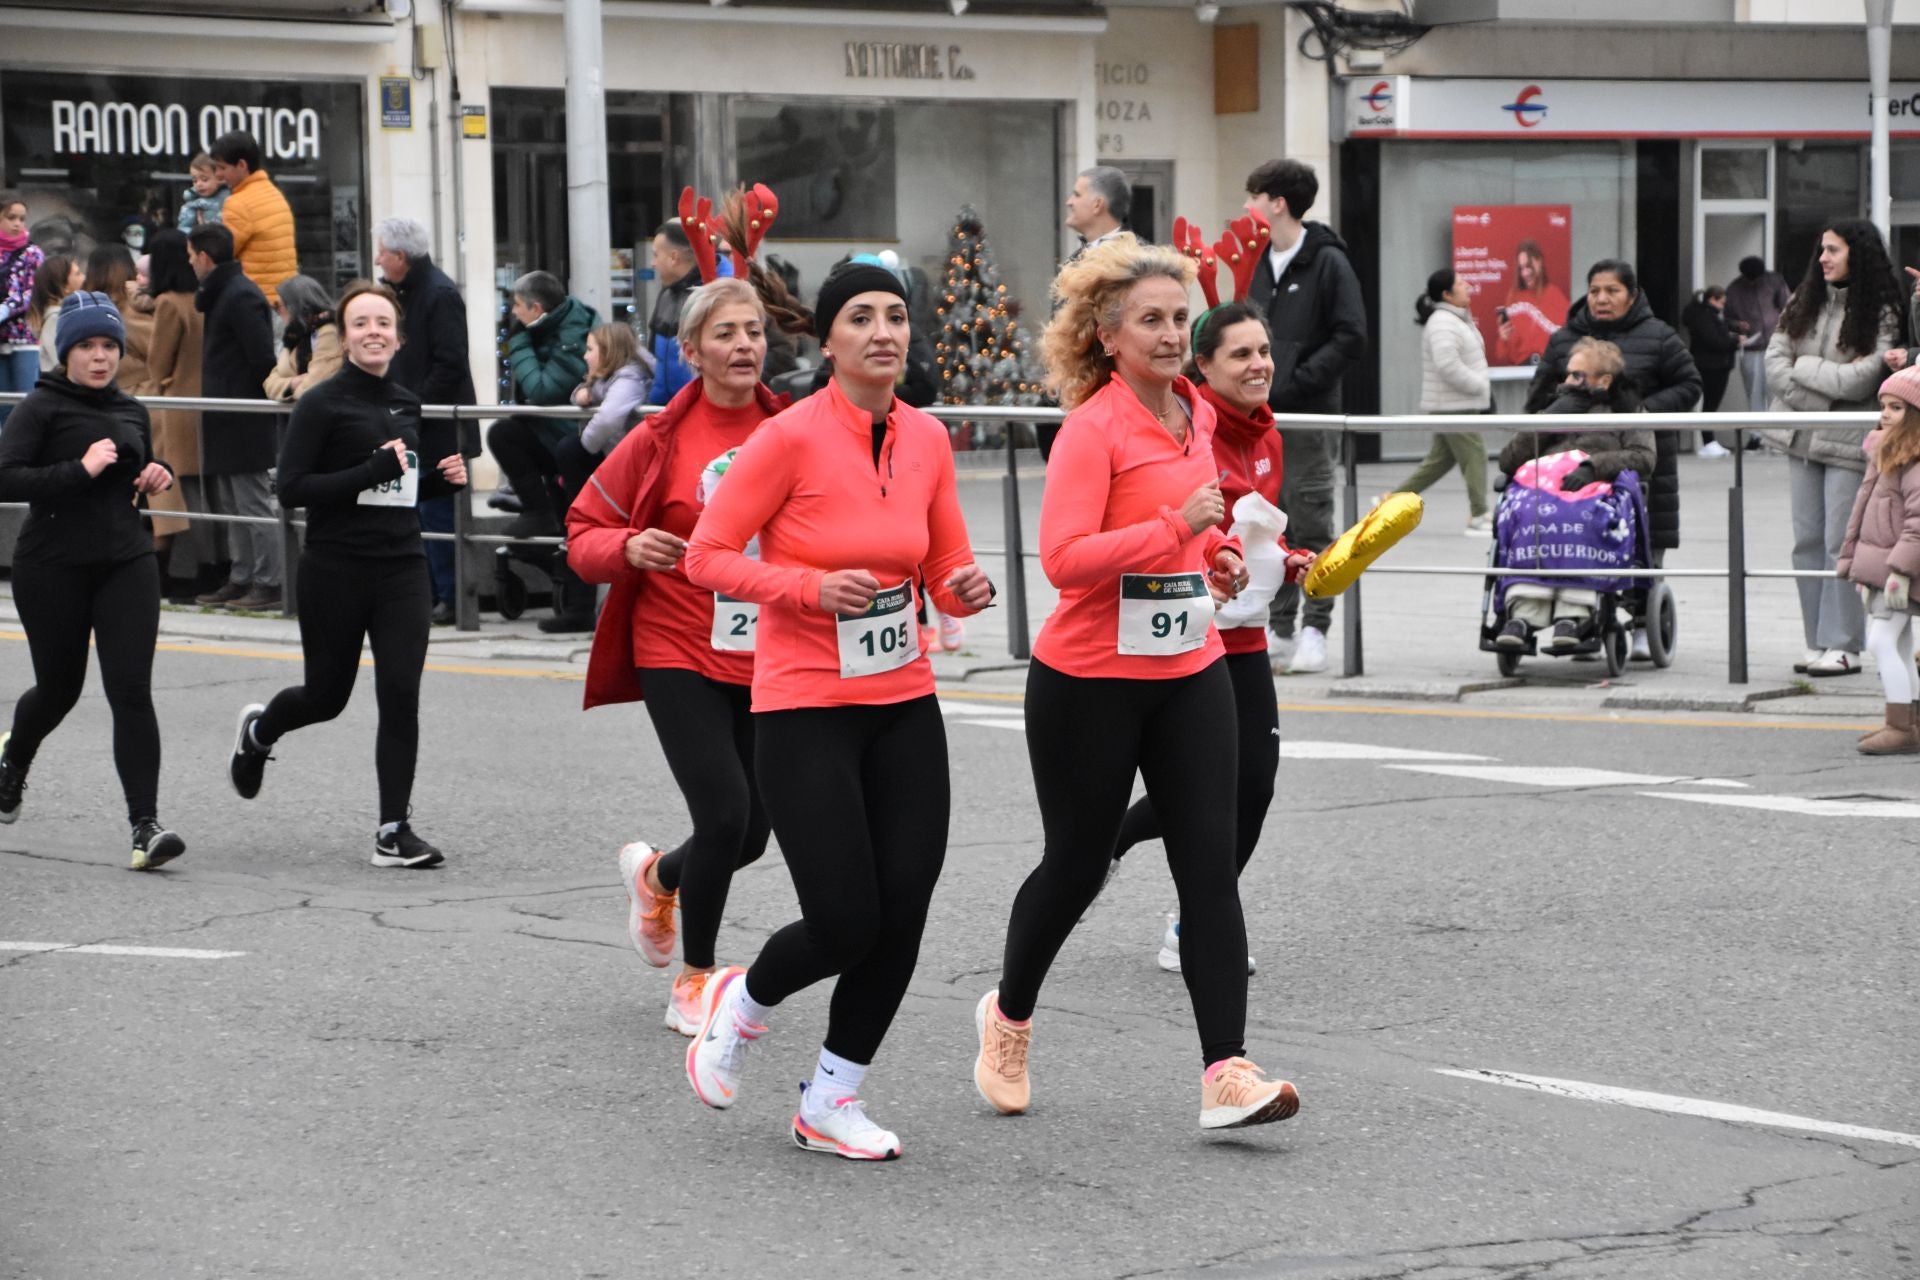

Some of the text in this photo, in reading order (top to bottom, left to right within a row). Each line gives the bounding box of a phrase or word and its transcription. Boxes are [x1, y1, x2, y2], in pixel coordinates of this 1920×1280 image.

[1869, 93, 1920, 116] ierC
[52, 100, 189, 154] RAMON
[1522, 523, 1557, 535] VIDA
[1562, 523, 1584, 534] DE
[1151, 611, 1188, 638] 91
[859, 621, 908, 656] 105
